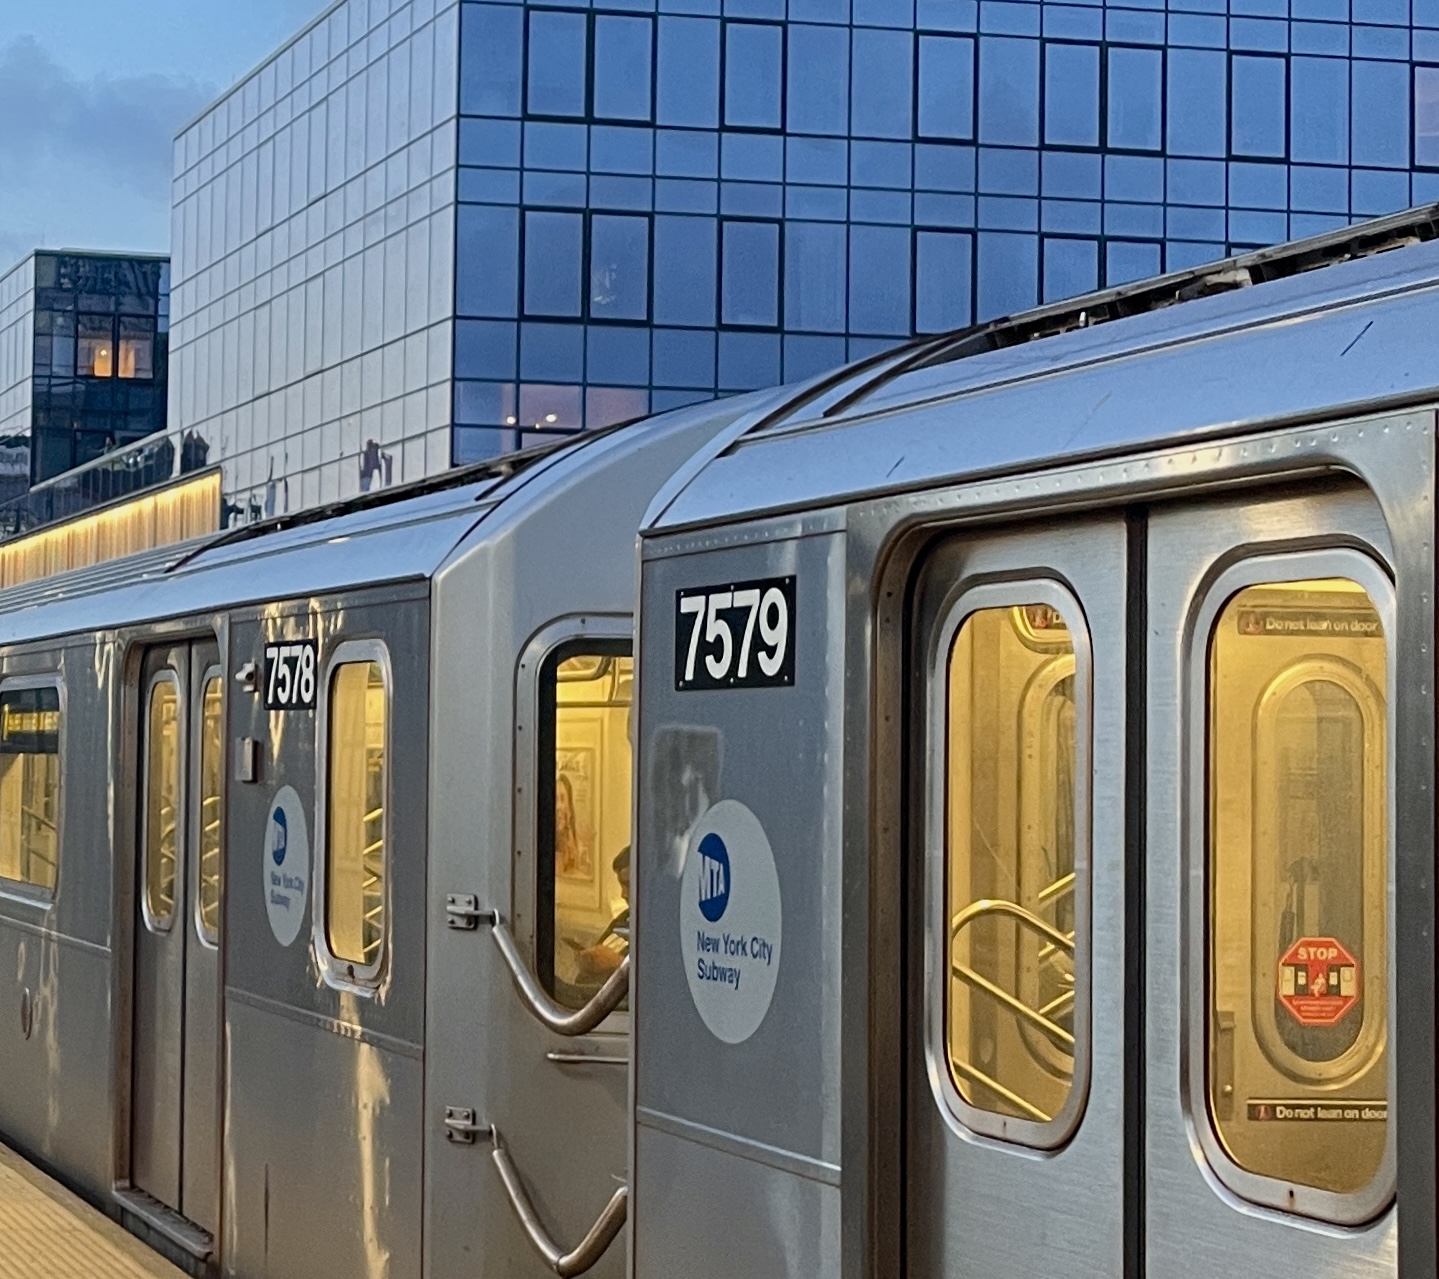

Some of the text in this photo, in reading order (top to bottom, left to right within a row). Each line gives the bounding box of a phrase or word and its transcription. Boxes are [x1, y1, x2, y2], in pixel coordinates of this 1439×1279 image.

[680, 587, 788, 681] 7579
[1265, 617, 1282, 630] Do
[1333, 621, 1349, 631] on
[1350, 620, 1379, 632] door
[266, 644, 315, 704] 7578
[698, 851, 726, 901] MTA
[697, 930, 773, 966] New York City
[1298, 947, 1338, 960] STOP
[697, 957, 741, 990] Subway
[1276, 1106, 1293, 1118] Do
[1295, 1107, 1315, 1119] not
[1344, 1109, 1359, 1119] on
